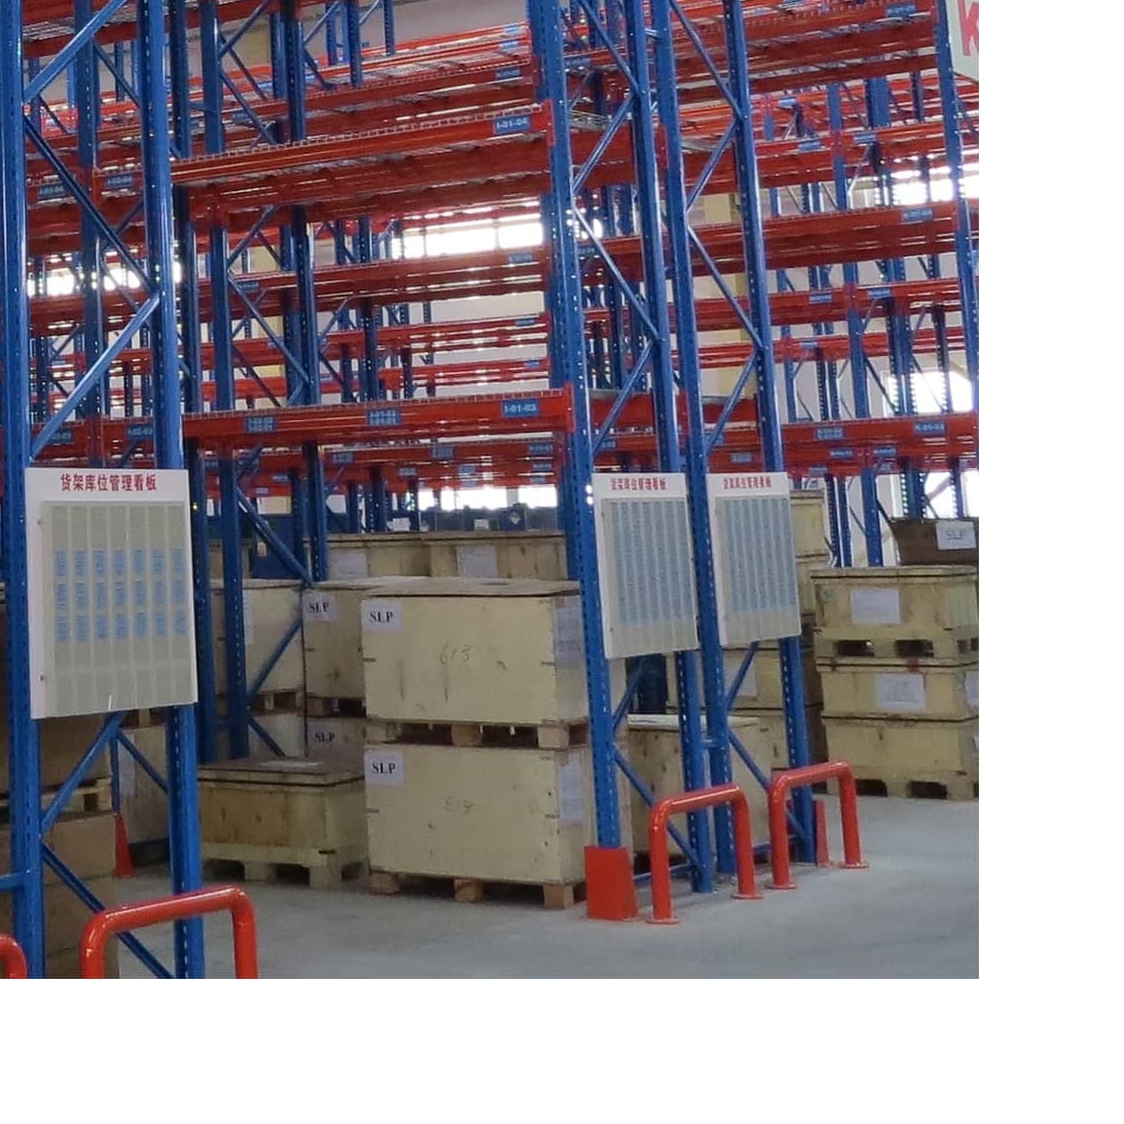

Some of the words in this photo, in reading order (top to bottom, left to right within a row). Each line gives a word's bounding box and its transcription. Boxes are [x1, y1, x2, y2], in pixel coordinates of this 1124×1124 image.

[60, 473, 157, 492] 货架库位管理看板
[309, 603, 330, 614] SLP
[370, 611, 393, 623] SLP
[372, 762, 395, 774] SLP
